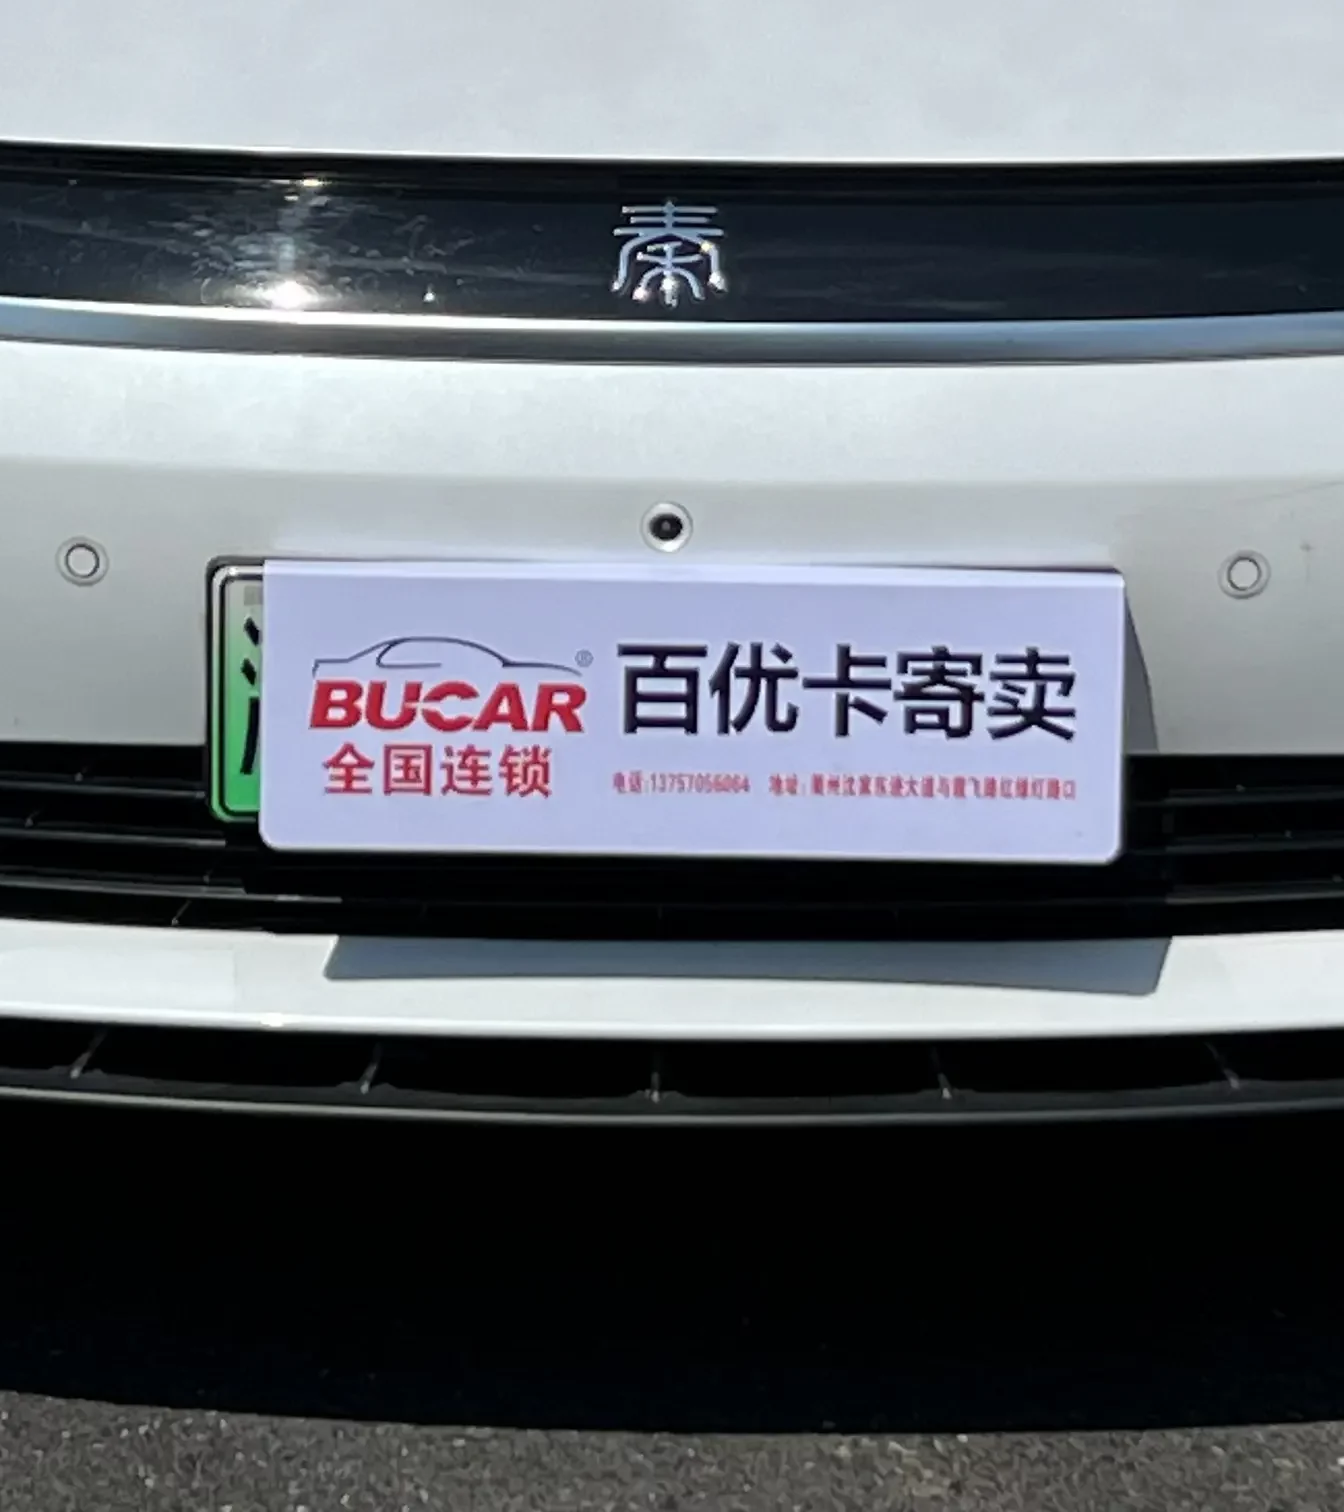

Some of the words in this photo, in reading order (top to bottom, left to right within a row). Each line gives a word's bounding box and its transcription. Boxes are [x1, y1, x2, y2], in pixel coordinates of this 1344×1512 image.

[309, 679, 587, 732] BUCAR
[616, 641, 1077, 741] 百优卡寄卖
[322, 742, 553, 799] 全国连锁
